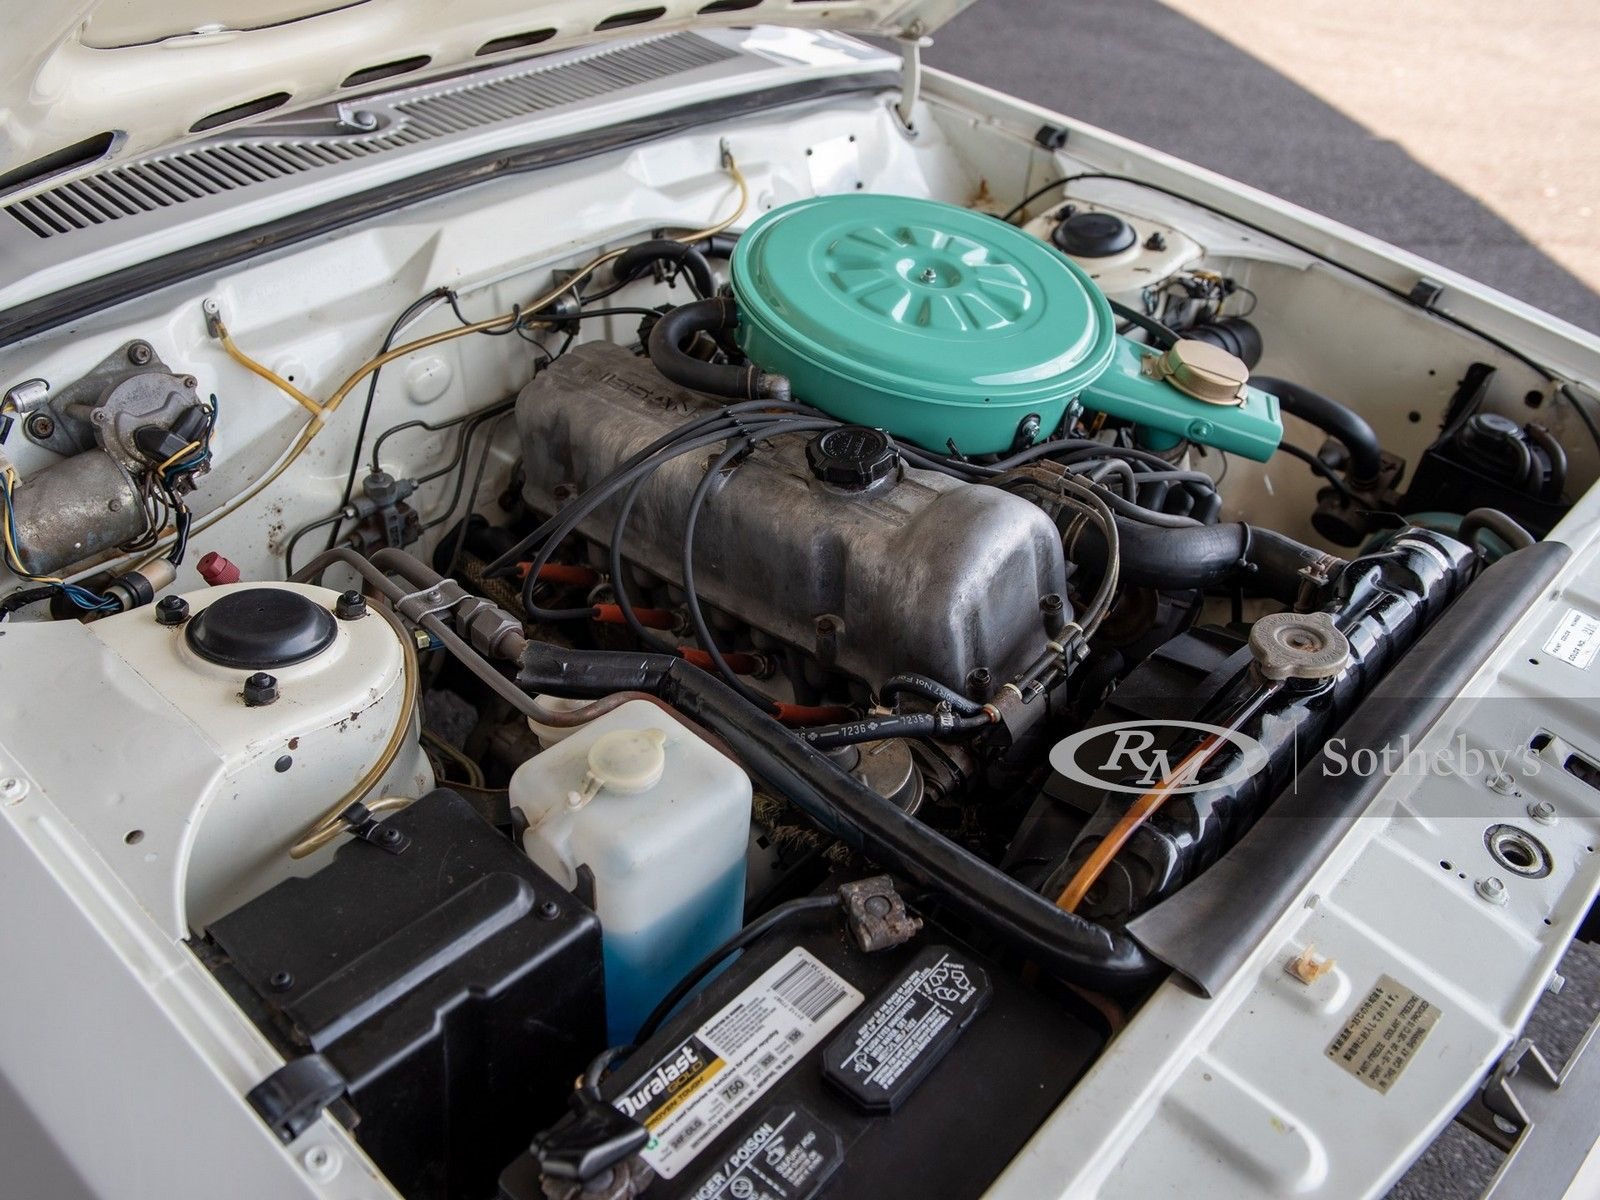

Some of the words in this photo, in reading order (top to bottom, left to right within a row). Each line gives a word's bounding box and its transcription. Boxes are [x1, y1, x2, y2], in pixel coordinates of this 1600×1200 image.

[915, 676, 932, 690] Not
[841, 724, 866, 736] 7236
[615, 1046, 698, 1118] Duralast
[667, 1061, 704, 1093] GOLD
[677, 1076, 705, 1101] TOUGH
[722, 1078, 745, 1100] 750
[730, 1122, 774, 1168] POISON
